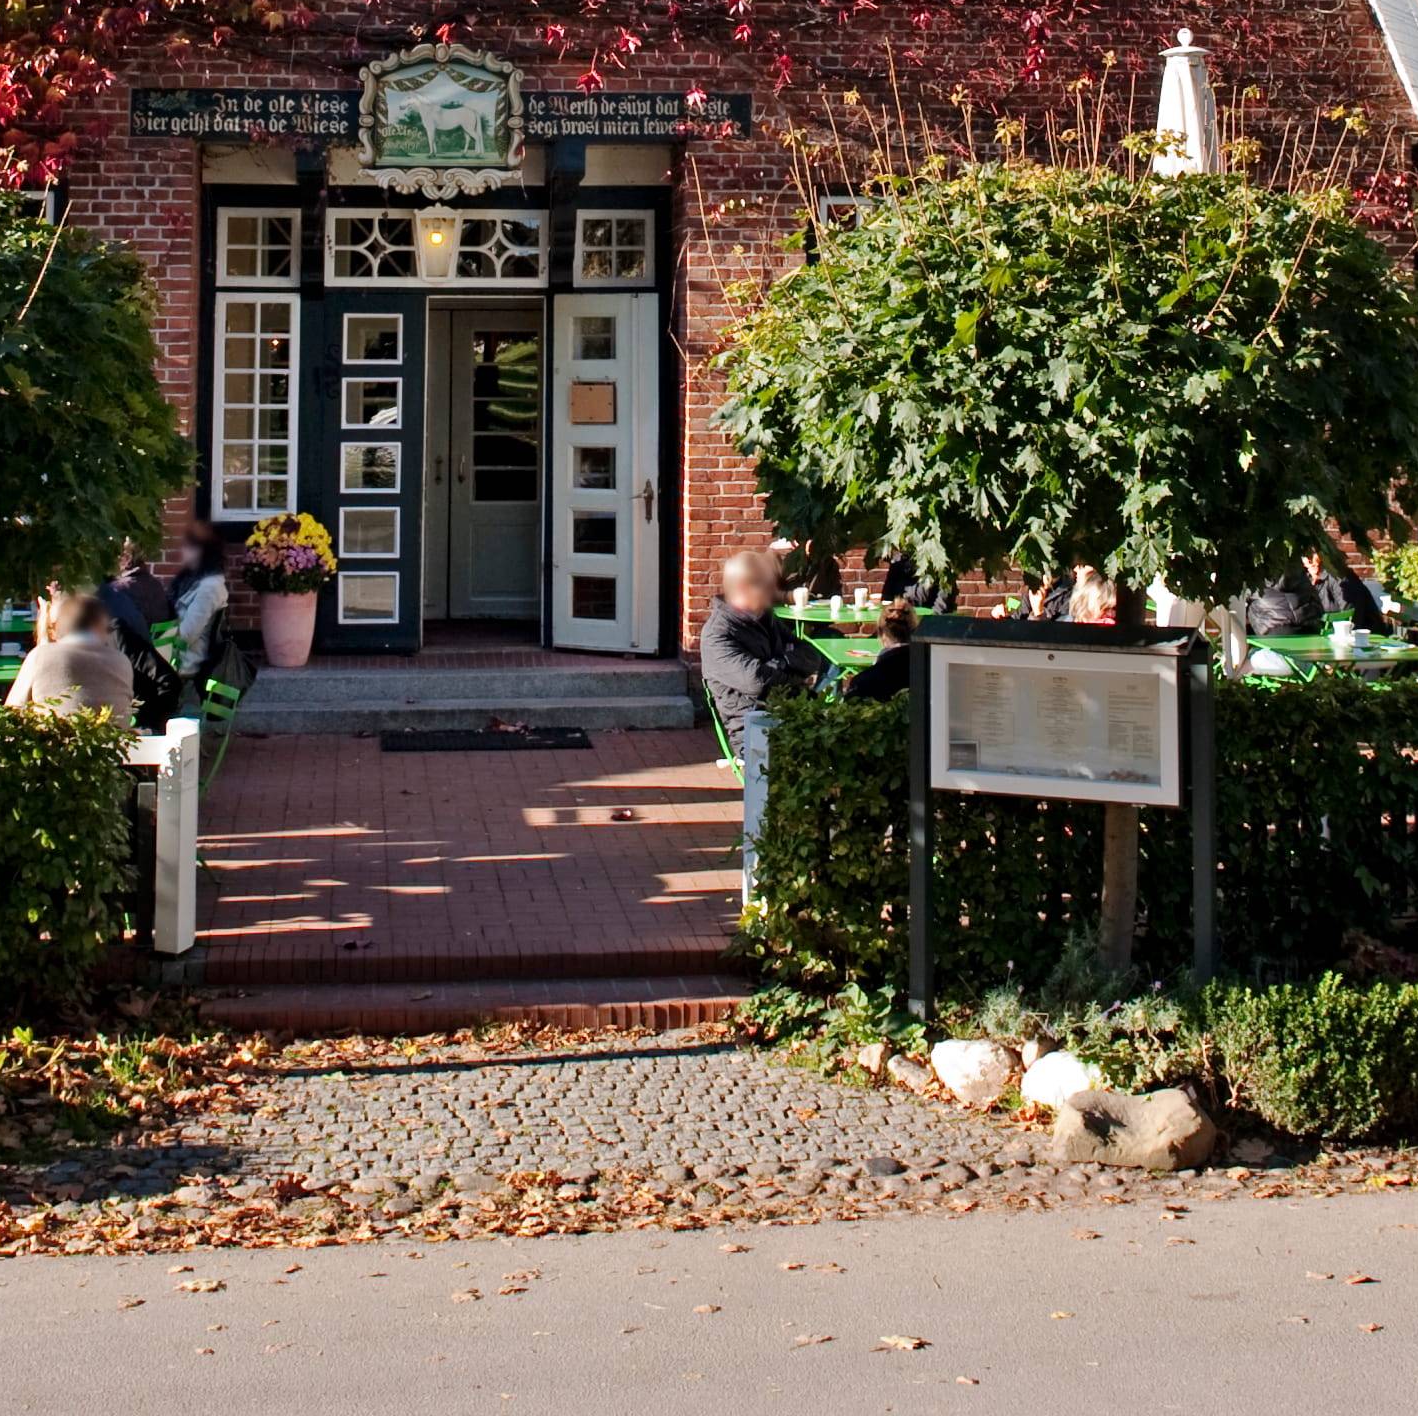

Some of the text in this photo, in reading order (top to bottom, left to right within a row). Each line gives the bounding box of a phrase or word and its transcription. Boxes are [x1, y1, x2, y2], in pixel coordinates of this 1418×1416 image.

[212, 93, 349, 114] In de ole Liese
[528, 94, 546, 116] de
[548, 95, 598, 119] Werth
[600, 95, 617, 116] de
[655, 95, 679, 116] dat
[133, 110, 168, 134] Hier
[213, 112, 241, 133] dat
[268, 114, 288, 134] de
[291, 114, 349, 134] Wiese
[603, 116, 640, 135] mien
